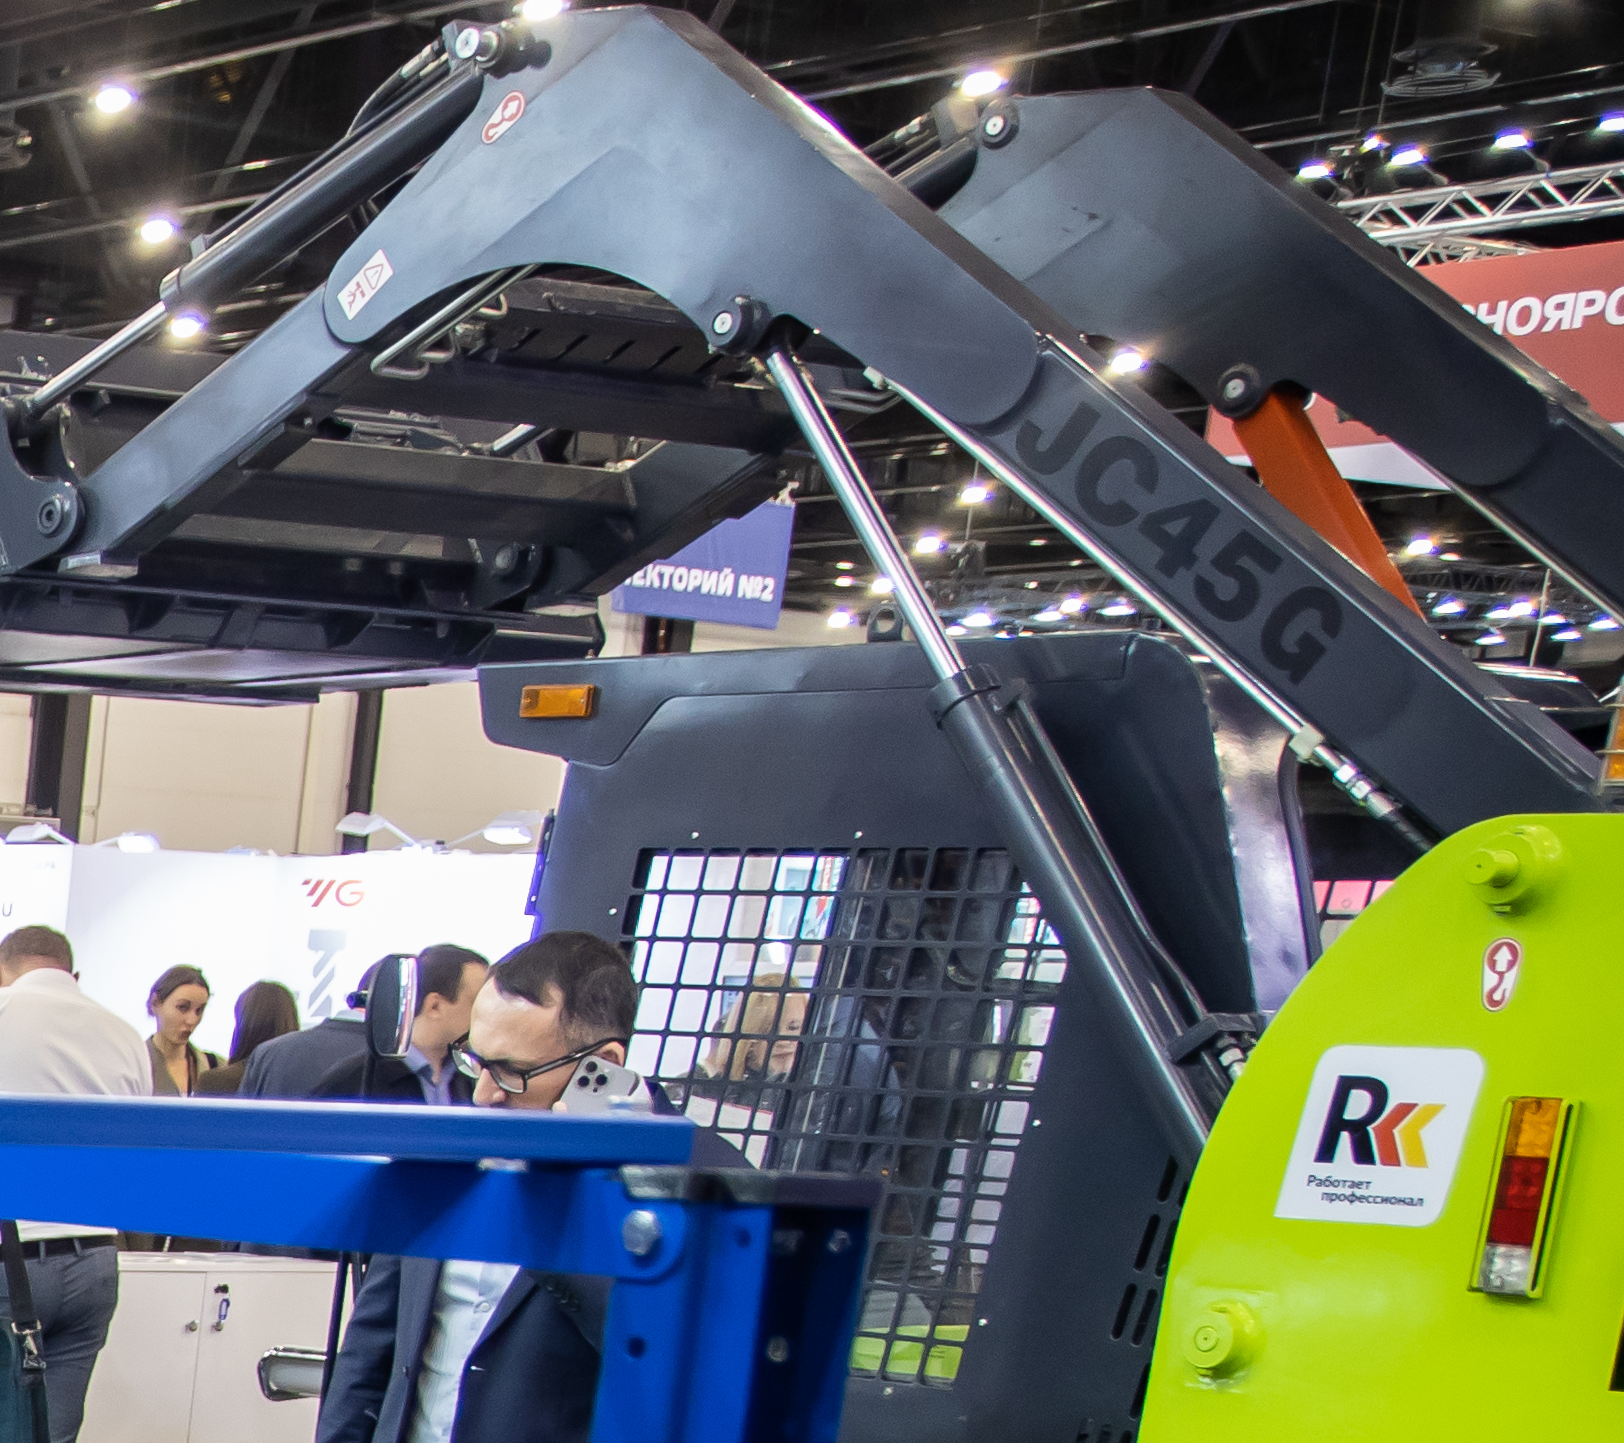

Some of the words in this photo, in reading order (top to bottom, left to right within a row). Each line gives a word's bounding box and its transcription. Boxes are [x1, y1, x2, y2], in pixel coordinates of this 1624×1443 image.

[1461, 286, 1624, 336] НОЯРС
[1016, 401, 1343, 686] JC45G
[624, 563, 735, 597] ЕКТОРИЙ
[737, 574, 775, 602] №2
[1307, 1174, 1372, 1191] Работает
[1321, 1191, 1424, 1207] профессионал
